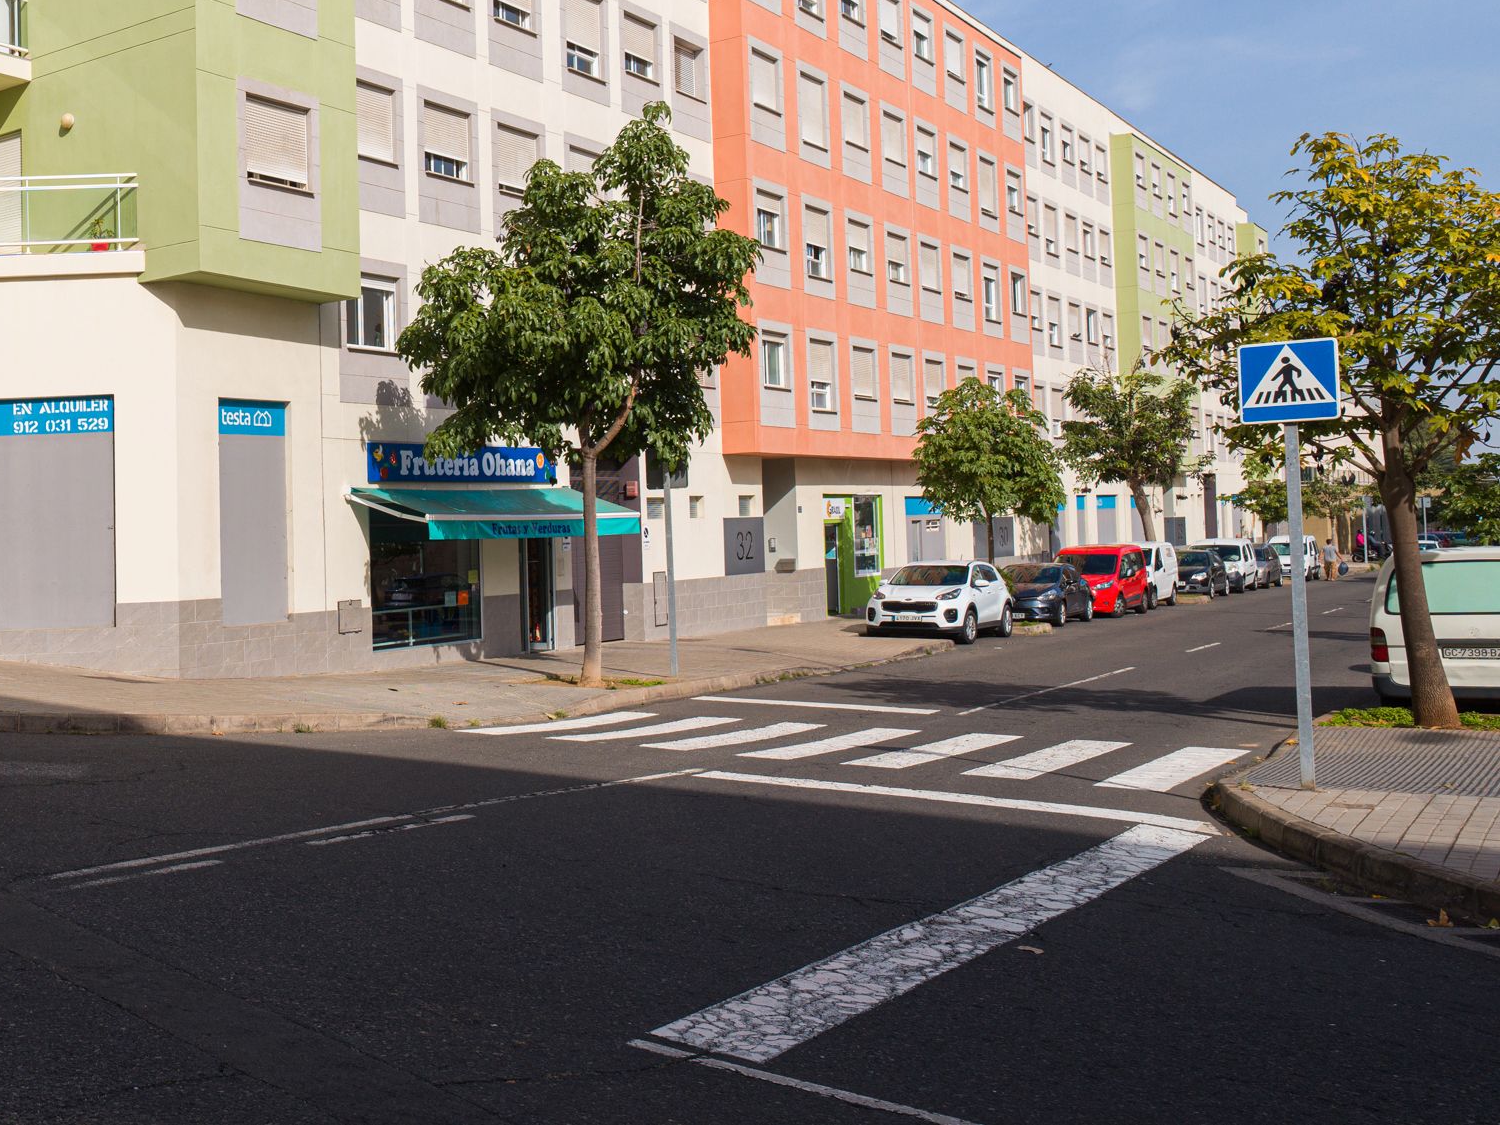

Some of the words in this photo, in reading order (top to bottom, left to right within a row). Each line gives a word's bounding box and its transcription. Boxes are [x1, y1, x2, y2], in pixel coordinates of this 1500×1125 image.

[13, 403, 32, 415] EN
[39, 399, 108, 414] ALQUILER
[13, 421, 39, 434] 912
[45, 419, 71, 432] 031
[78, 417, 109, 430] 529
[221, 408, 251, 426] testa
[482, 452, 535, 476] Ohana
[492, 523, 520, 535] Frutas
[523, 525, 528, 534] y
[532, 522, 571, 534] Verduras
[736, 531, 754, 560] 32
